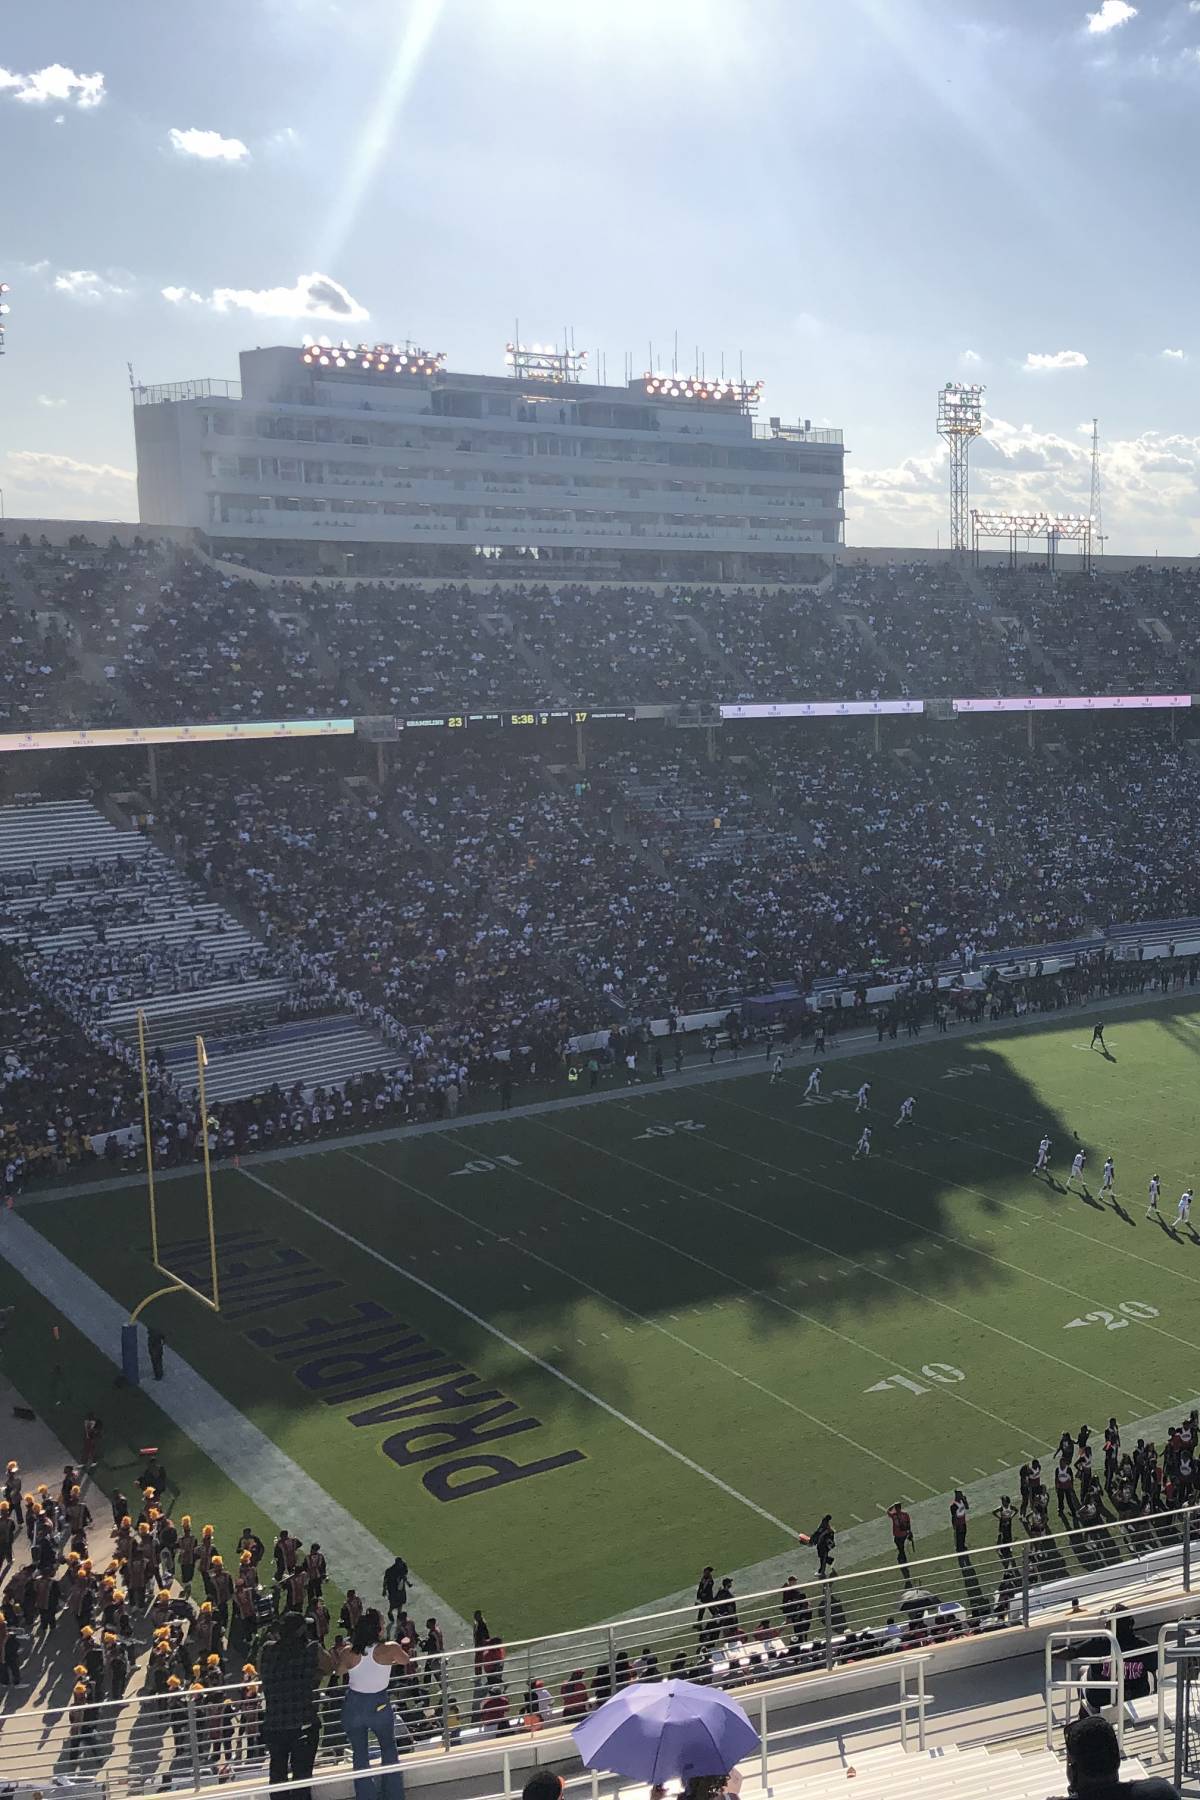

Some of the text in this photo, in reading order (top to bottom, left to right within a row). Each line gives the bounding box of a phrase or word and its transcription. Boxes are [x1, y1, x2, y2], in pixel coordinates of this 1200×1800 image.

[448, 717, 463, 728] 23
[511, 714, 534, 725] 5:36
[575, 713, 588, 722] 17
[1085, 1301, 1161, 1331] 20
[886, 1362, 966, 1396] 10
[242, 1300, 588, 1502] PRAIRIE
